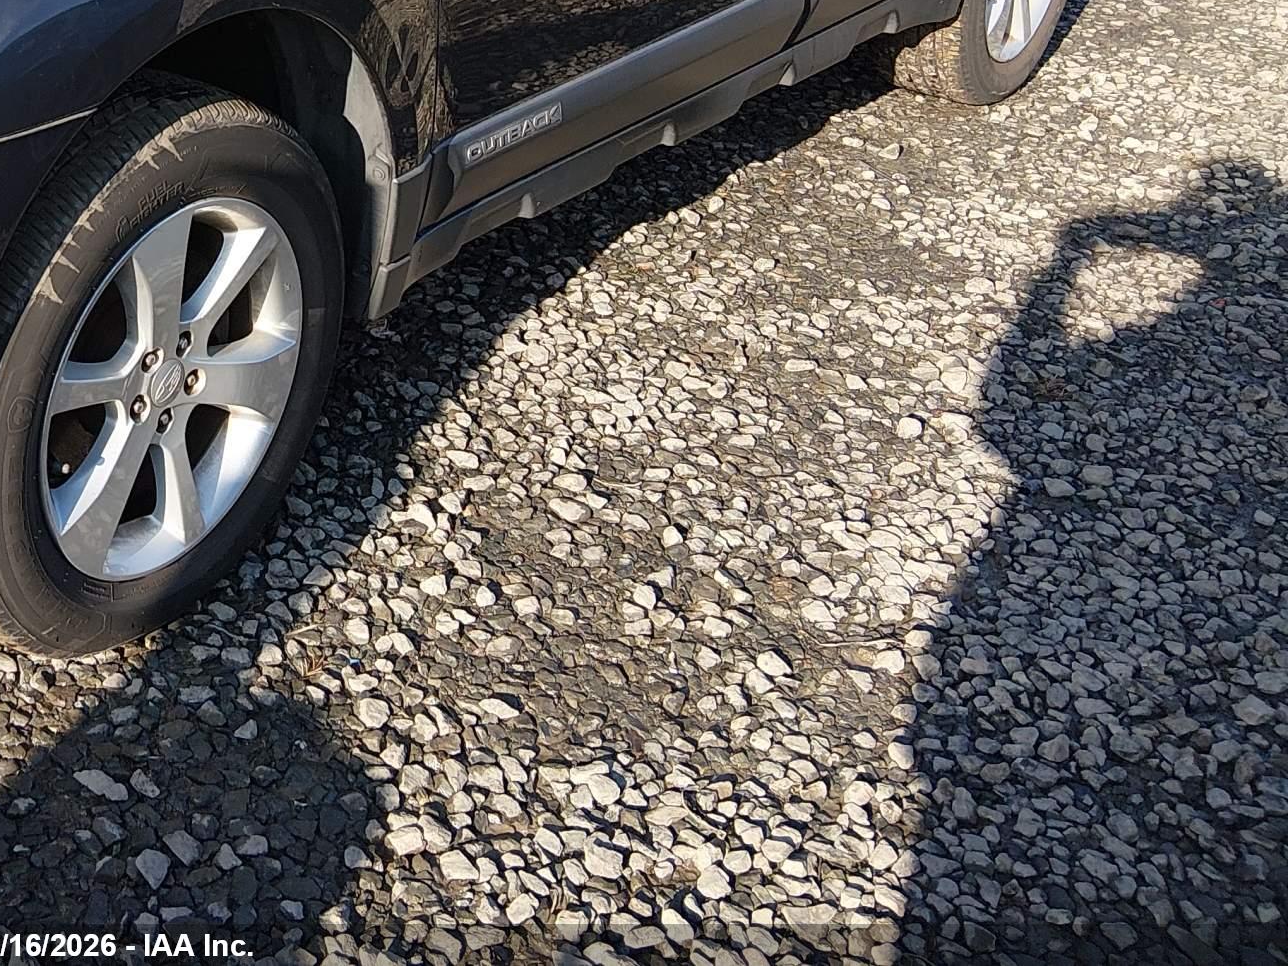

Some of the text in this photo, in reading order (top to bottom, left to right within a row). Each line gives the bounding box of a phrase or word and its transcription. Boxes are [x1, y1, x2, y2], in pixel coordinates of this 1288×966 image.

[466, 101, 563, 163] OUTBACK
[128, 181, 185, 229] FIGHTER
[137, 180, 171, 212] FUEL
